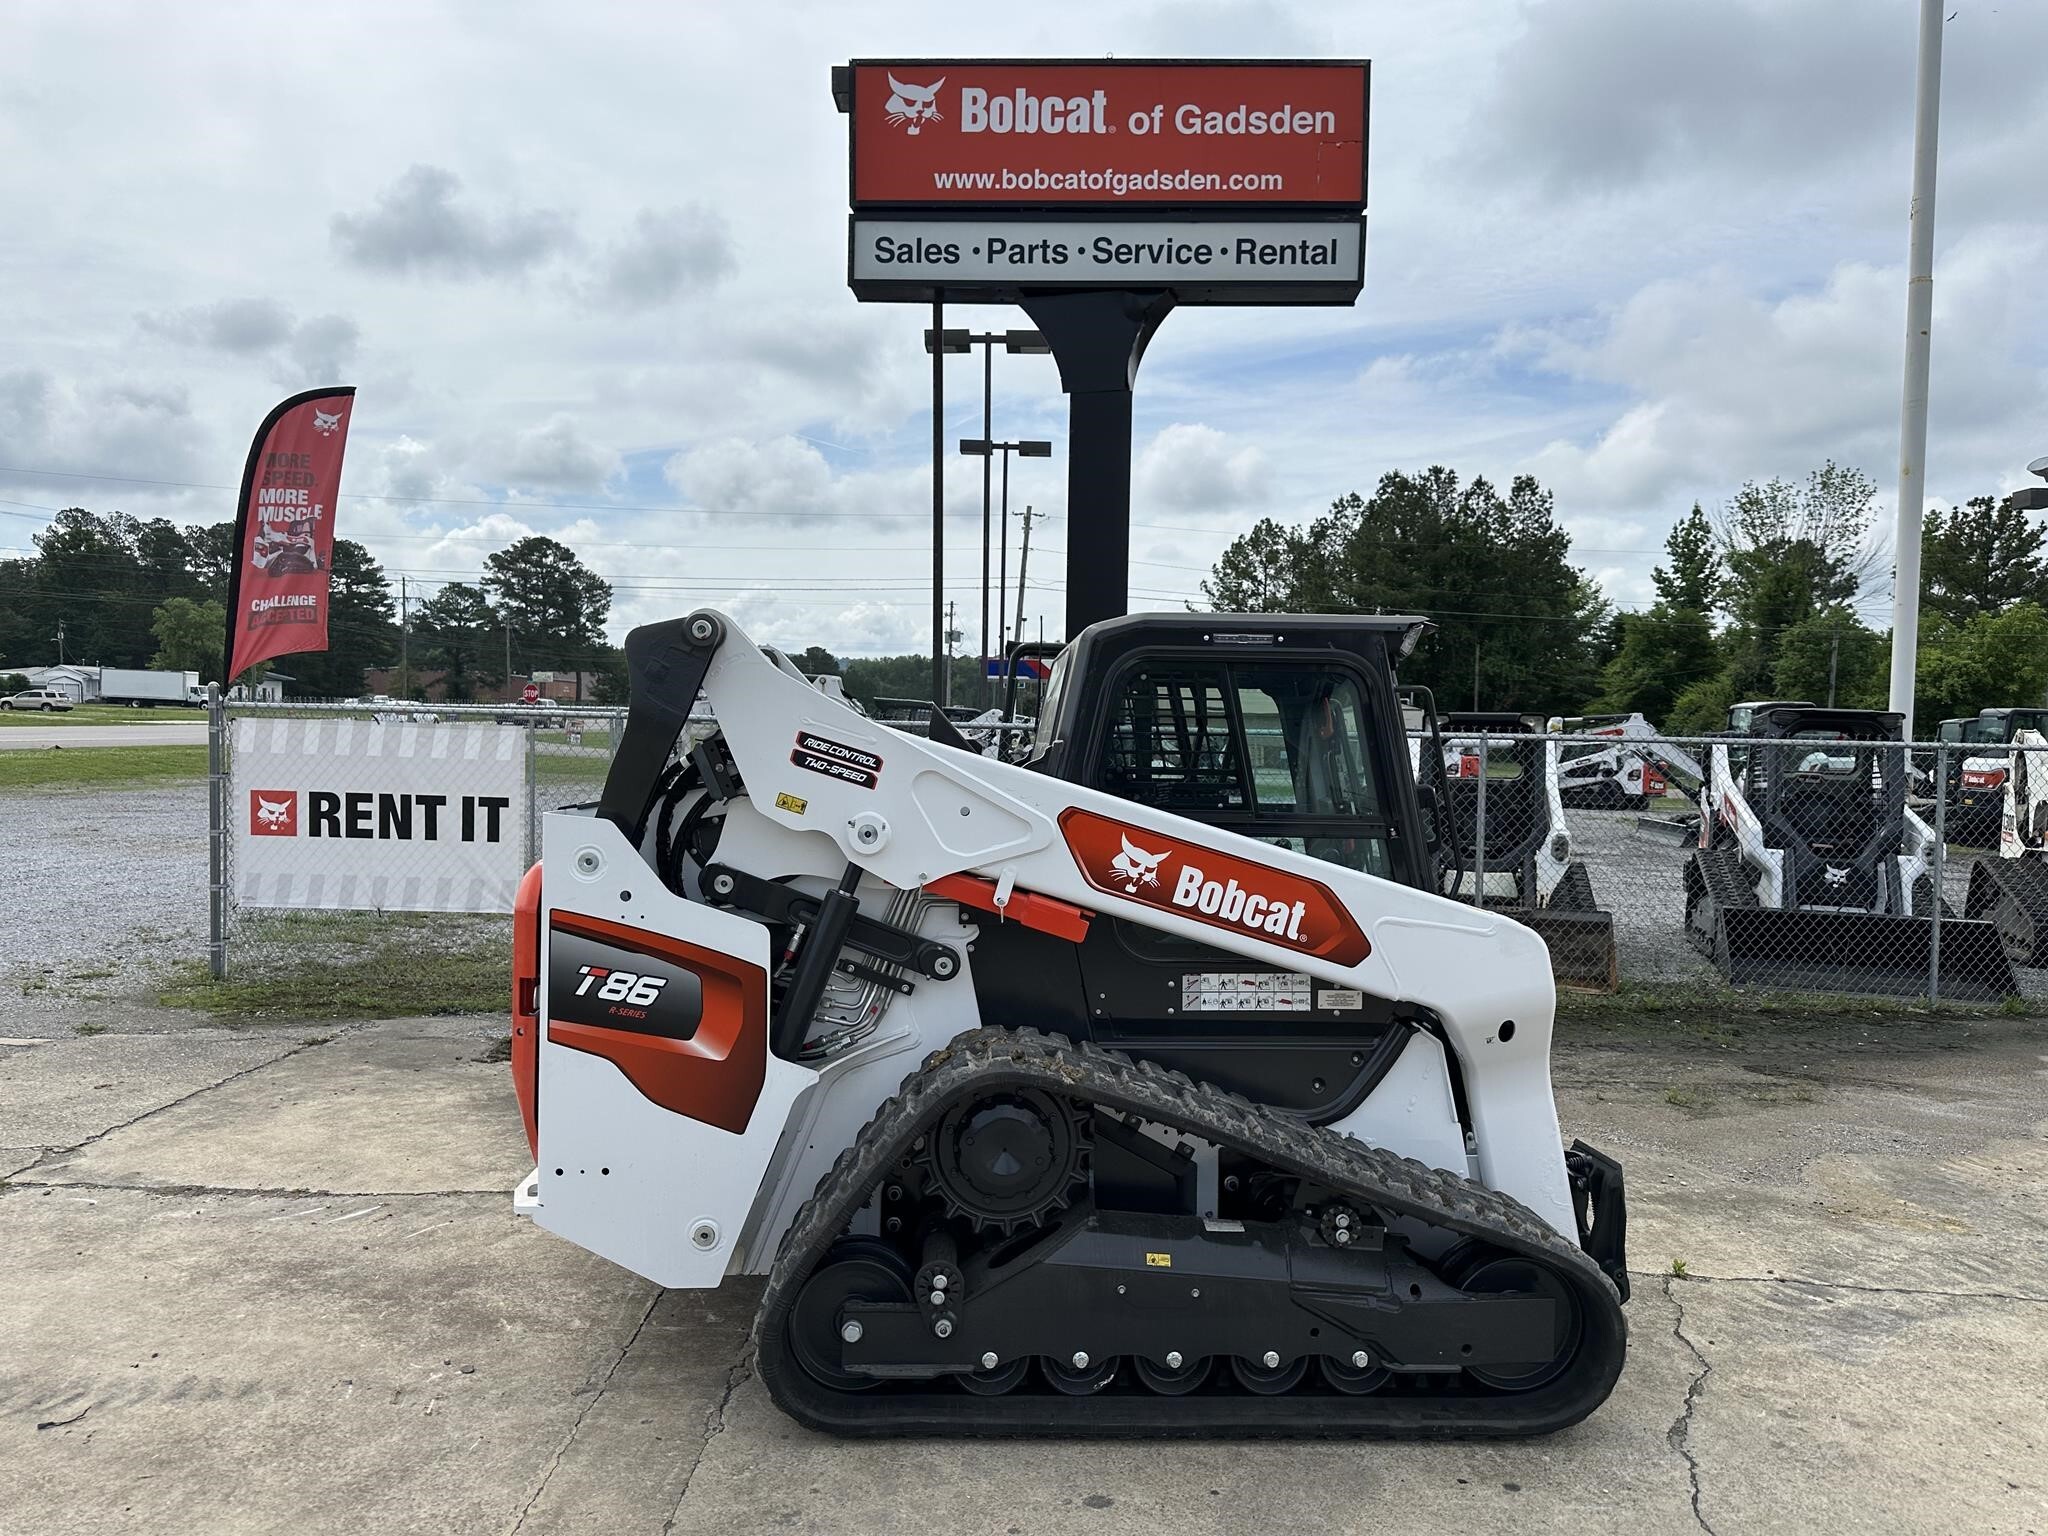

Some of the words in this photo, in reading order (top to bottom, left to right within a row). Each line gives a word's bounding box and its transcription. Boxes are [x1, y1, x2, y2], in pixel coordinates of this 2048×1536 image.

[961, 87, 1108, 134] Bobcat
[1128, 104, 1164, 135] of
[1174, 104, 1336, 135] Gadsden
[934, 169, 1283, 195] www.bobcatofgadsden.com
[874, 236, 961, 265] Sales
[986, 238, 1070, 265] Parts
[1092, 237, 1213, 265] Service
[1235, 239, 1338, 266] Rental
[265, 452, 311, 469] MORE
[258, 488, 309, 505] MORE
[258, 504, 322, 522] MUSCLE
[252, 595, 316, 611] CHALLENGE
[524, 690, 538, 698] STOP
[804, 738, 831, 751] RIDE
[829, 746, 876, 767] CONTROL
[805, 757, 867, 781] TWO-SPEED
[308, 791, 447, 841] RENT
[461, 796, 510, 843] IT
[1172, 864, 1306, 940] Bobcat
[574, 966, 667, 1006] T86
[609, 1007, 647, 1018] R-SERIES
